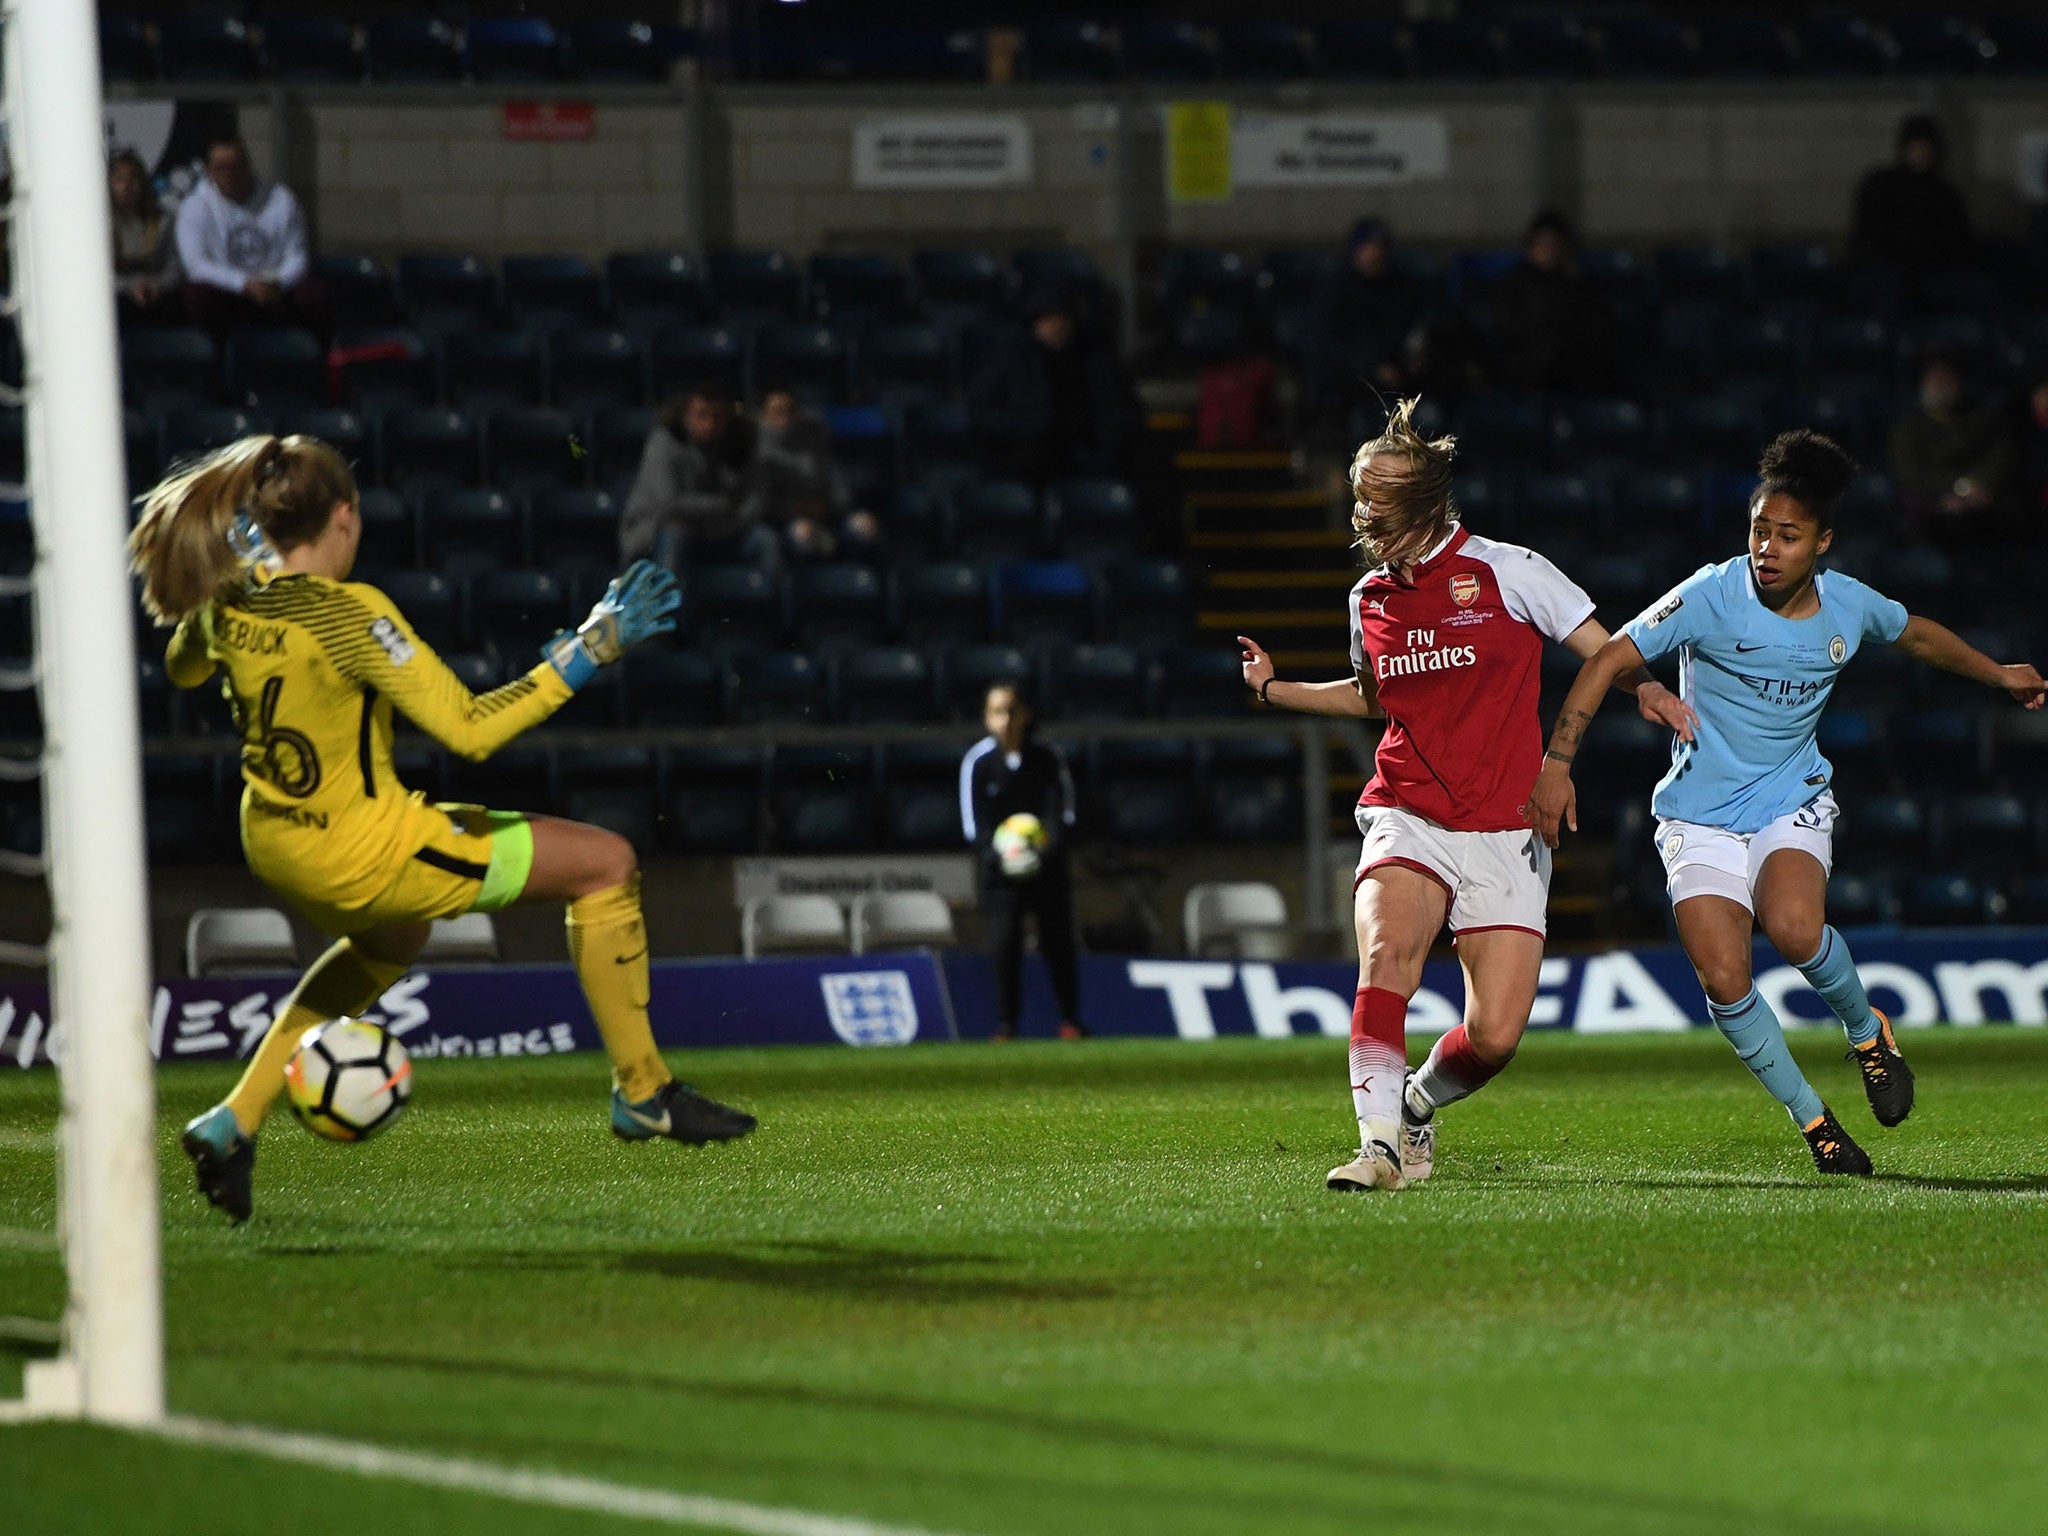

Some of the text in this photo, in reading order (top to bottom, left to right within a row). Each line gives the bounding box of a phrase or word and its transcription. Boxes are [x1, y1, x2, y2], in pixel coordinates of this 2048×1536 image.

[1453, 579, 1475, 587] Arsenal
[216, 616, 288, 656] EBUCK
[1407, 629, 1435, 648] Fly
[1378, 645, 1476, 680] Emirates
[1128, 951, 2048, 1041] TheFAcom
